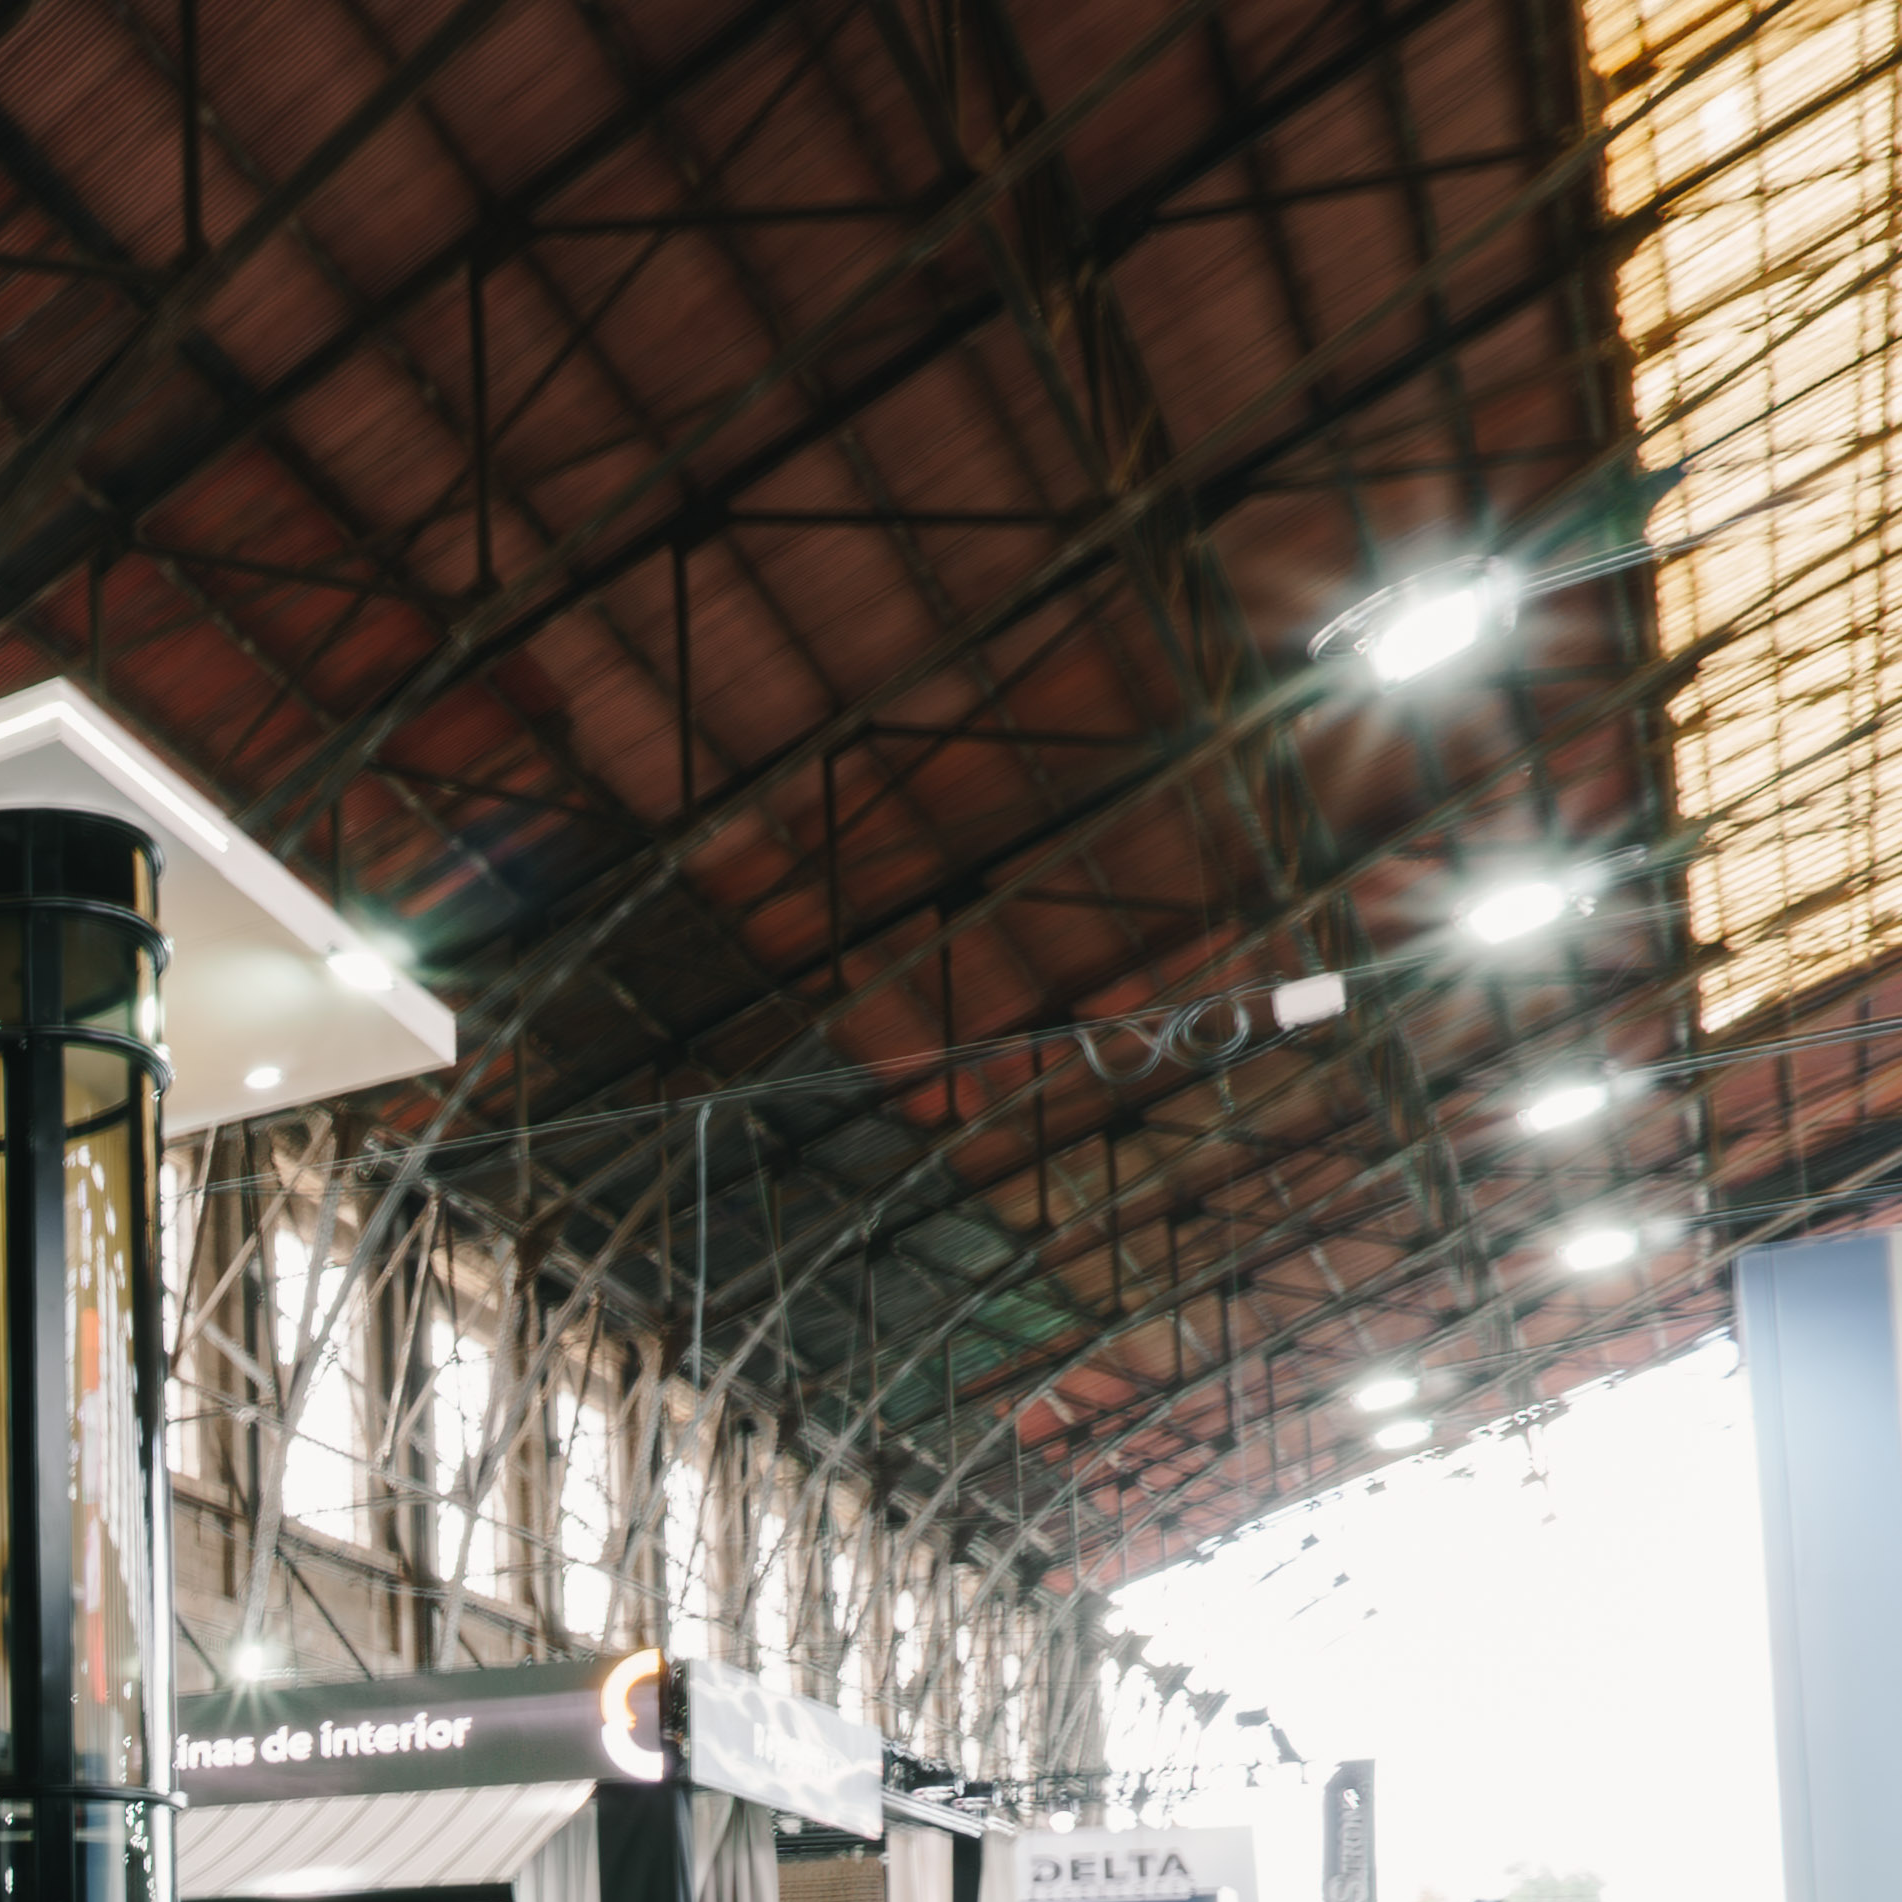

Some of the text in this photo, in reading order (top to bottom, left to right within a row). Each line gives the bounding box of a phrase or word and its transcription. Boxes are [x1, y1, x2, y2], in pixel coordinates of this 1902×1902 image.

[174, 1711, 473, 1770] inas de interior
[1030, 1850, 1189, 1882] DELTA
